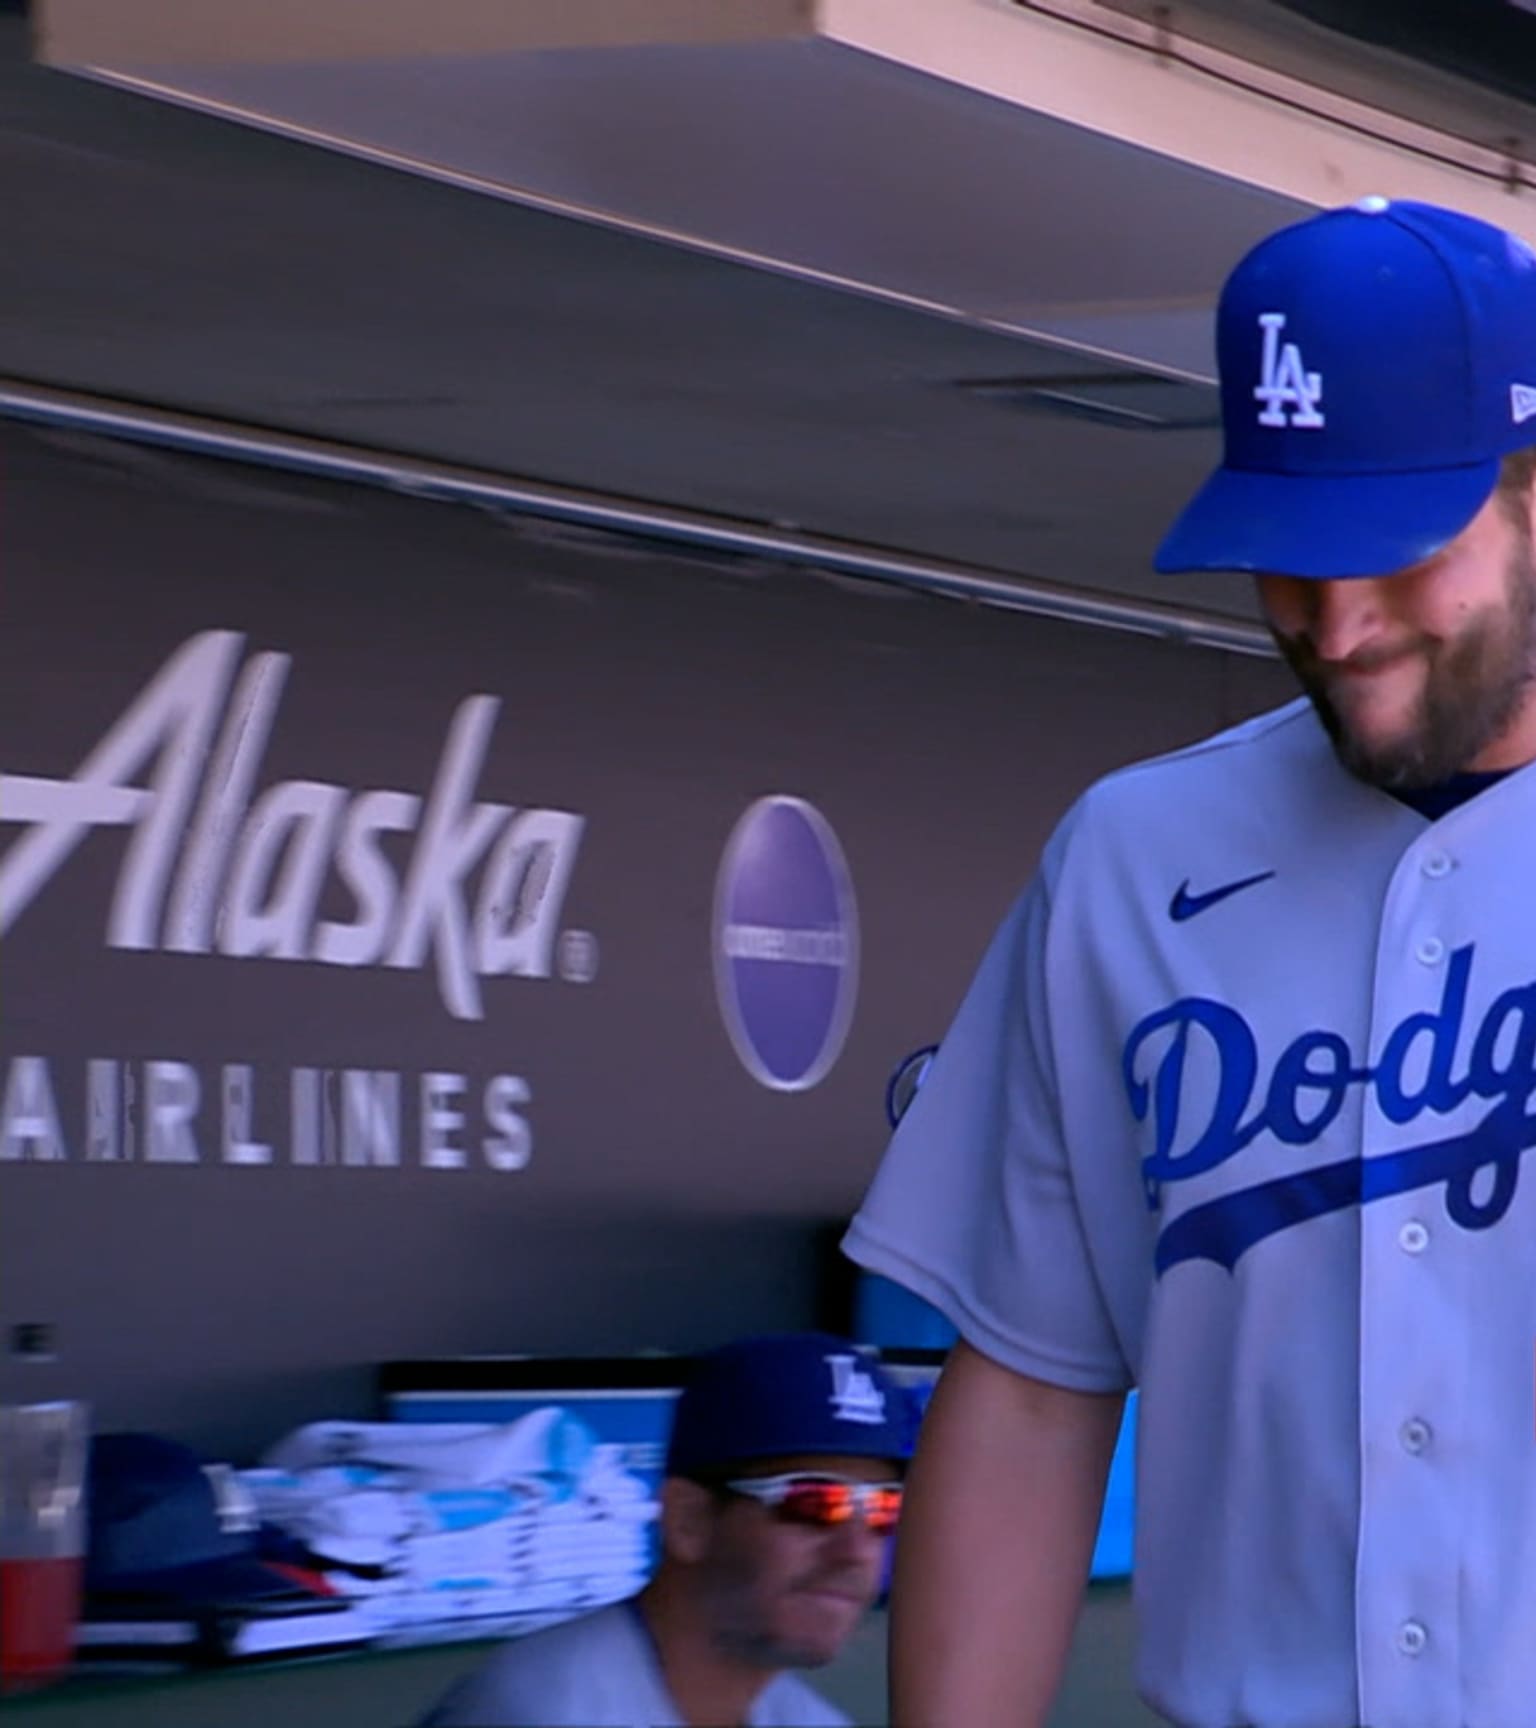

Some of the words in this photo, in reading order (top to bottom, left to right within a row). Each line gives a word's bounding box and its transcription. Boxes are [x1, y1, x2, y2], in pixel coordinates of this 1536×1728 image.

[1254, 313, 1325, 428] LA
[0, 629, 585, 1020] Alaska
[2, 1056, 534, 1170] AIRLINES
